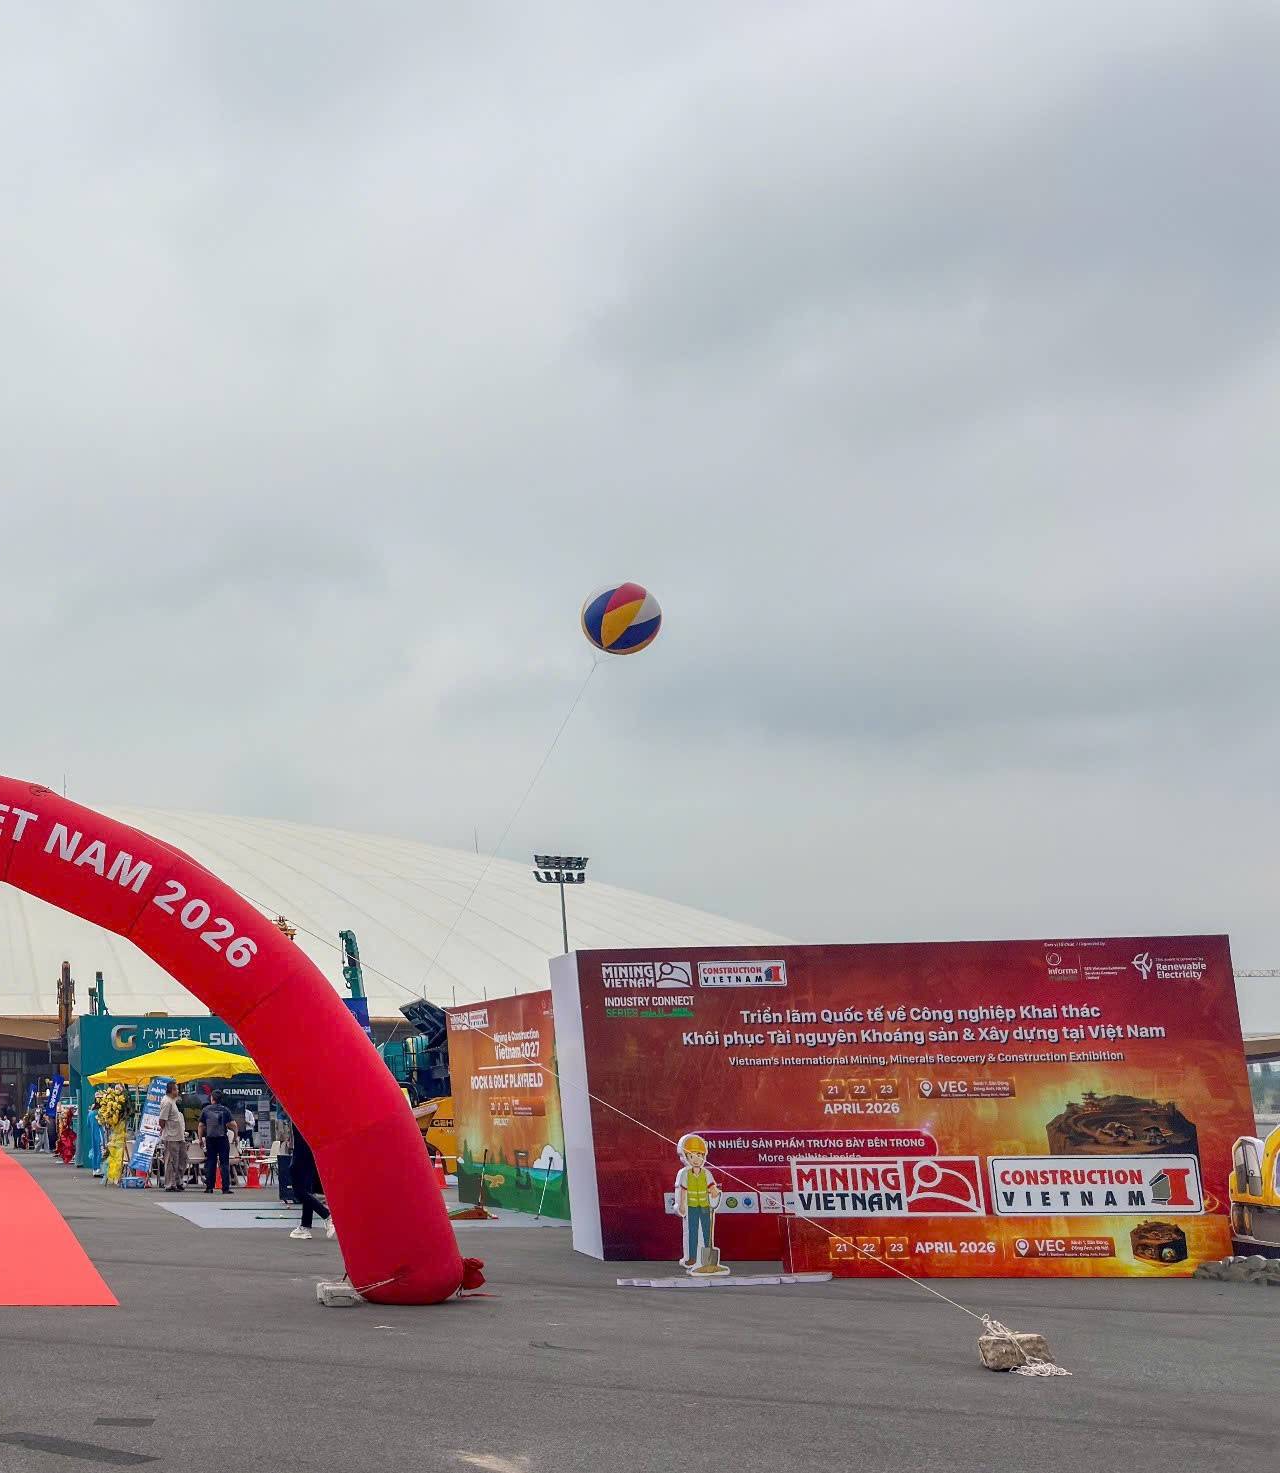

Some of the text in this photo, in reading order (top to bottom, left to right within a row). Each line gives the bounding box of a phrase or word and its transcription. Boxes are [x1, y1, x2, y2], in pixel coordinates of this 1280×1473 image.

[43, 822, 153, 894] NAM
[152, 879, 259, 969] 2026
[601, 965, 654, 979] MINING
[702, 966, 762, 975] CONSTRUCTION
[1048, 967, 1078, 975] informa
[1156, 962, 1207, 972] Renewable
[703, 975, 763, 984] VIETNAM
[1157, 970, 1202, 980] Electricity
[603, 977, 655, 988] VIETNAM
[604, 995, 694, 1007] INDUSTRY CONNECT
[740, 1003, 1100, 1024] Triển lãm Quốc tế về Công nghiệp Khai thác
[142, 1028, 191, 1040] 广州工控
[682, 1024, 1166, 1049] Khôi phục Tài nguyên Khoáng sản & Xây dựng tại Việt Nam
[728, 1051, 1125, 1067] Vietnam's International Mining, Minerals Recovery & Construction Exhibition
[222, 1088, 263, 1096] SUNWARD
[827, 1085, 893, 1094] 21 22 23
[938, 1081, 968, 1094] VEC
[824, 1102, 900, 1114] APRIL 2026
[888, 1138, 925, 1147] TRONG
[758, 1153, 784, 1163] More
[796, 1167, 900, 1192] MINING
[1000, 1169, 1143, 1186] CONSTRUCTION
[799, 1192, 903, 1212] VIETNAM
[1002, 1190, 1145, 1207] VIETNAM
[835, 1241, 996, 1254] 21 22 23 APRIL 2026
[1035, 1239, 1065, 1252] VEC
